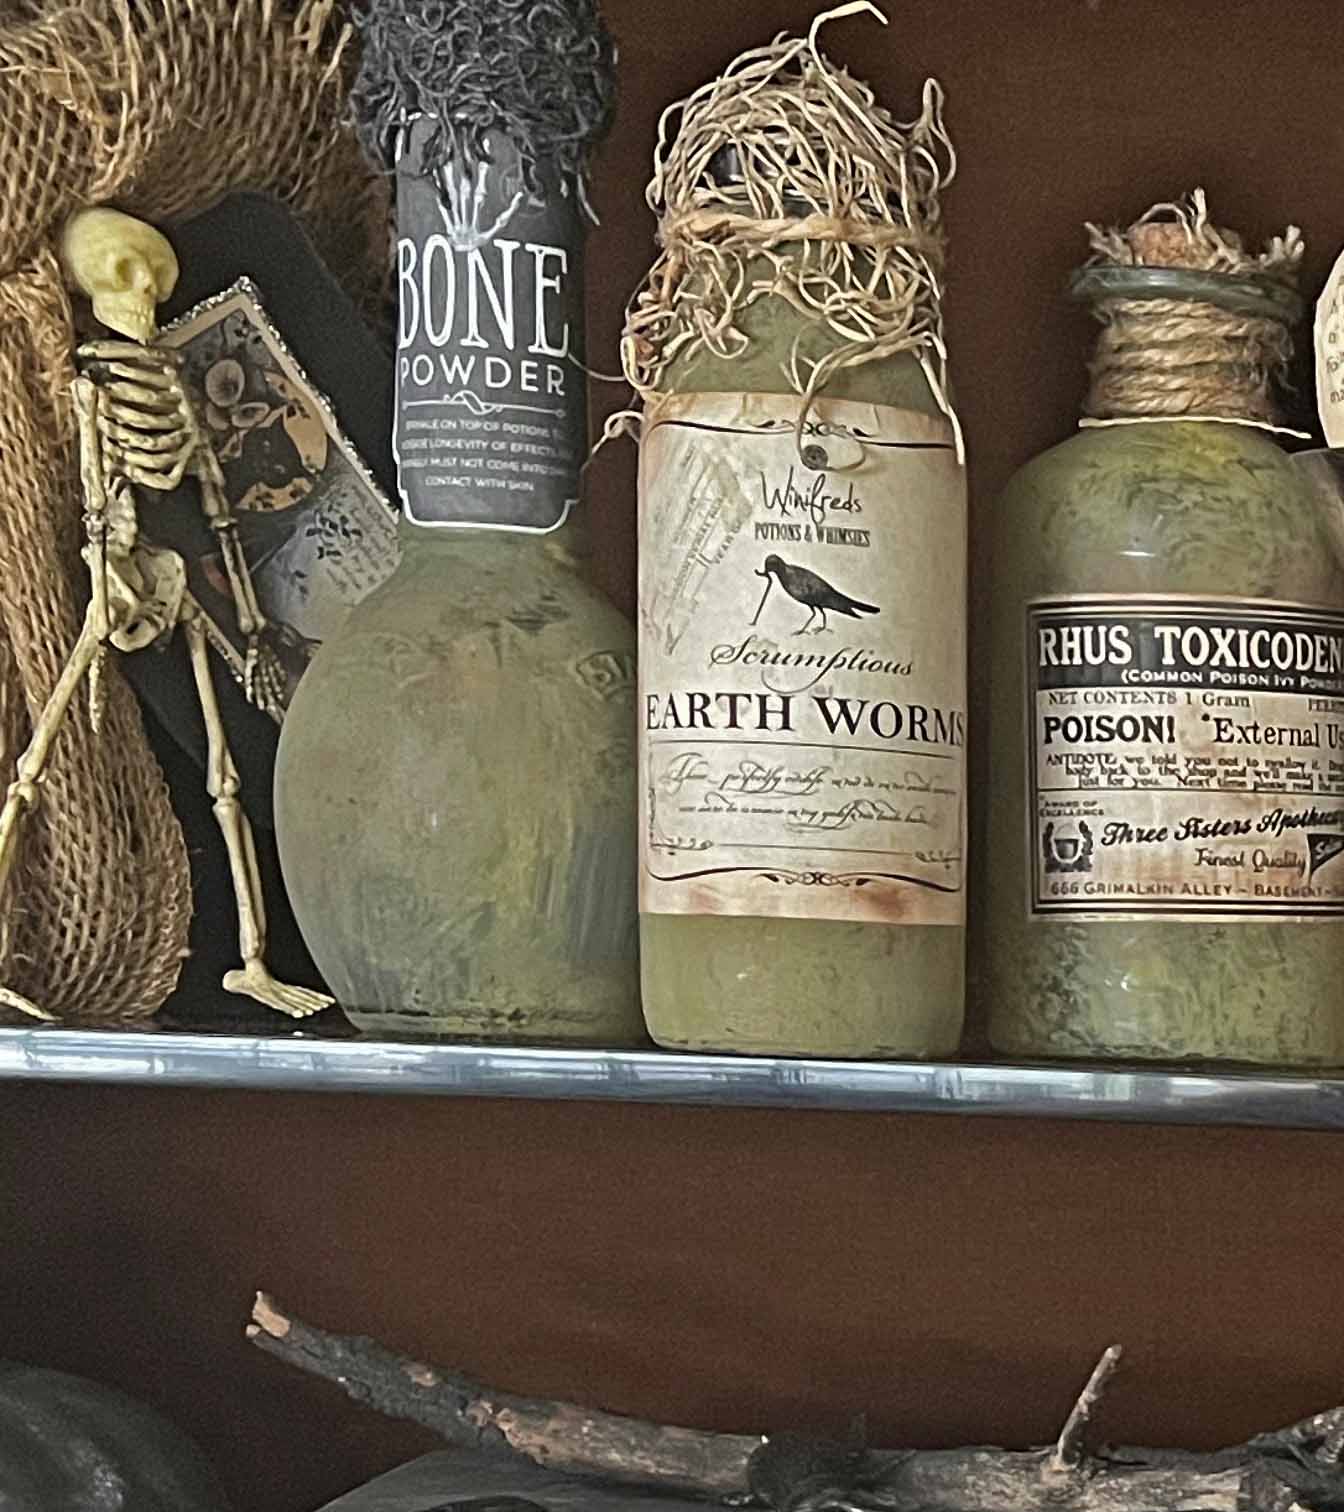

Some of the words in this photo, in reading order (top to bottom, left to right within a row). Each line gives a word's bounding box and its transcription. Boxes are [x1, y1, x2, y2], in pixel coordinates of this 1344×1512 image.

[398, 234, 569, 357] BONE
[400, 354, 566, 396] POWDER
[761, 465, 863, 524] Winifreds
[755, 522, 801, 541] POTIONS
[1039, 624, 1133, 667] RHUS
[708, 634, 914, 694] Scrumptious
[1121, 669, 1202, 684] (COMMON
[1210, 670, 1269, 687] POISON
[1049, 691, 1078, 705] NET
[1083, 691, 1177, 705] CONTENTS
[1202, 691, 1250, 708] Gram
[646, 691, 796, 732] EARTH
[811, 694, 966, 747] WORMS
[1044, 715, 1176, 744] POISON!
[1213, 717, 1320, 748] External
[1101, 821, 1169, 846] Three
[1174, 816, 1253, 841] Sisters
[1193, 847, 1245, 867] Finest
[1051, 881, 1079, 896] 666
[1181, 882, 1232, 896] ALLEY
